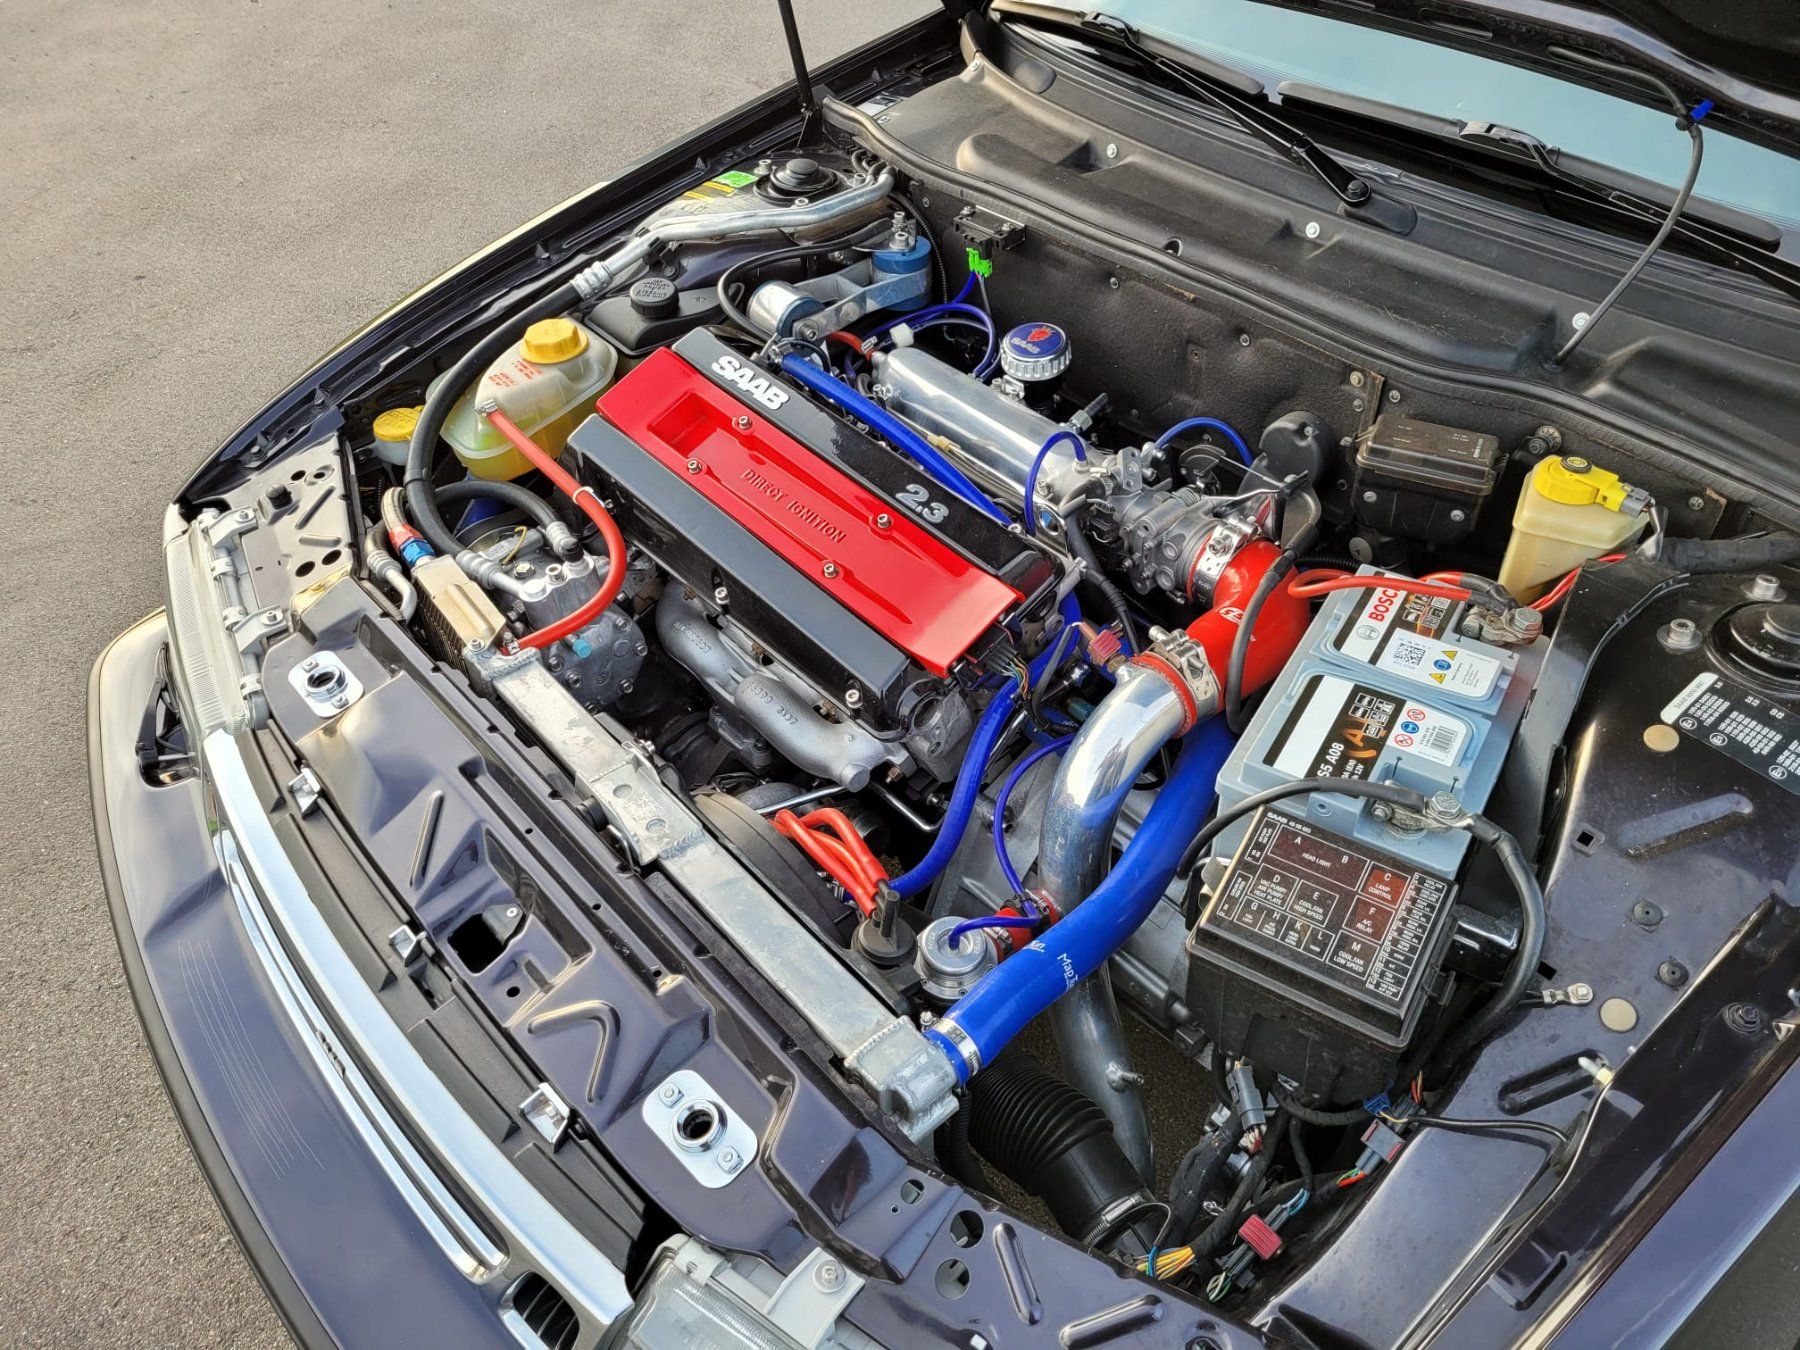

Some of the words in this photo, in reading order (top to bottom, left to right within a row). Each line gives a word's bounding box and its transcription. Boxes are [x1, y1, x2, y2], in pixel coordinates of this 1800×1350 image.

[1011, 338, 1040, 354] SAAB
[712, 356, 790, 410] SAAB
[741, 469, 788, 501] DIRECT
[787, 501, 847, 544] IGNITION
[895, 484, 950, 524] 2.3
[1368, 589, 1398, 622] BOSC
[1317, 764, 1332, 777] S5
[1326, 743, 1344, 764] A08
[1267, 812, 1287, 823] SAAB
[1302, 853, 1316, 861] HEAD
[1316, 858, 1331, 867] LIGHT
[1376, 883, 1390, 891] LAMP
[1313, 892, 1320, 900] E
[1369, 887, 1391, 900] CONTROL
[1267, 895, 1282, 905] PLATE
[1273, 911, 1280, 920] H
[1307, 910, 1323, 920] SPEED
[1295, 921, 1302, 930] K
[1356, 923, 1373, 933] RELAY
[1318, 931, 1322, 940] L
[1352, 942, 1361, 951] M
[1334, 956, 1346, 964] LOW
[1347, 962, 1363, 972] SPEED
